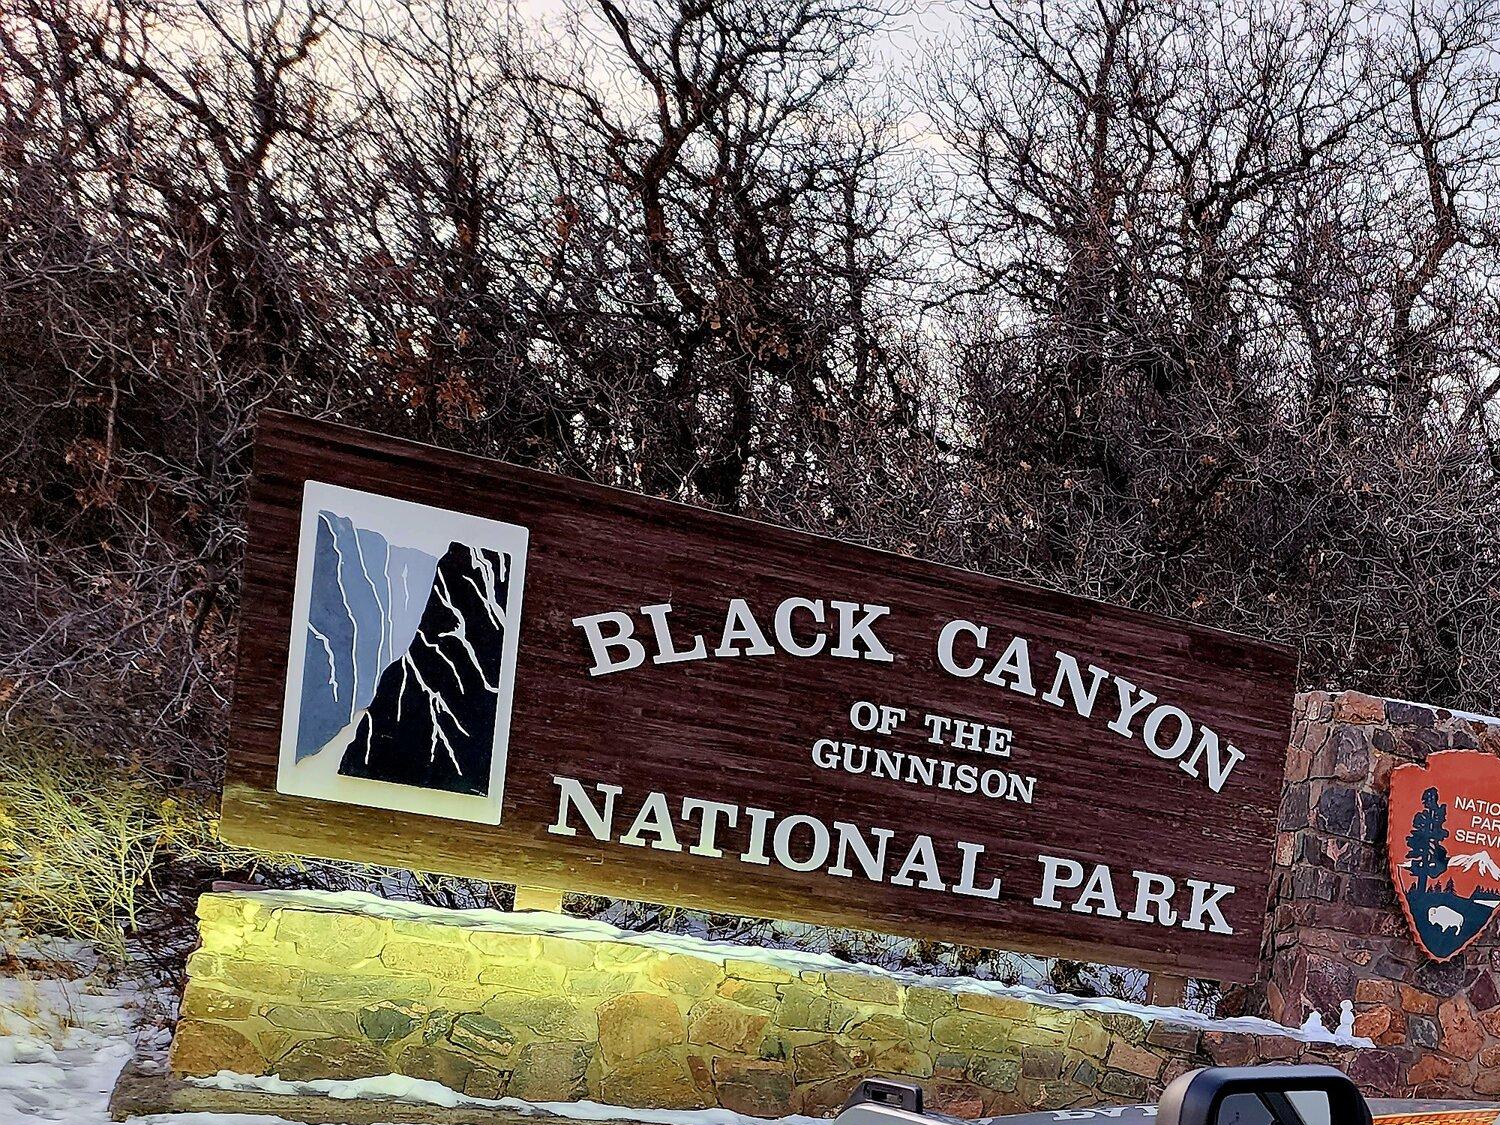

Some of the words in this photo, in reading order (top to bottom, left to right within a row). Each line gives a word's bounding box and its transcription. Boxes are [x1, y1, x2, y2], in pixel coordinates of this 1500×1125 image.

[572, 596, 894, 677] BLACK
[937, 619, 1246, 794] CANYON
[849, 701, 906, 735] OF
[924, 713, 1016, 758] THE
[811, 738, 1038, 805] GUNNISON
[547, 775, 1001, 900] NATIONAL
[1032, 854, 1236, 936] PARK
